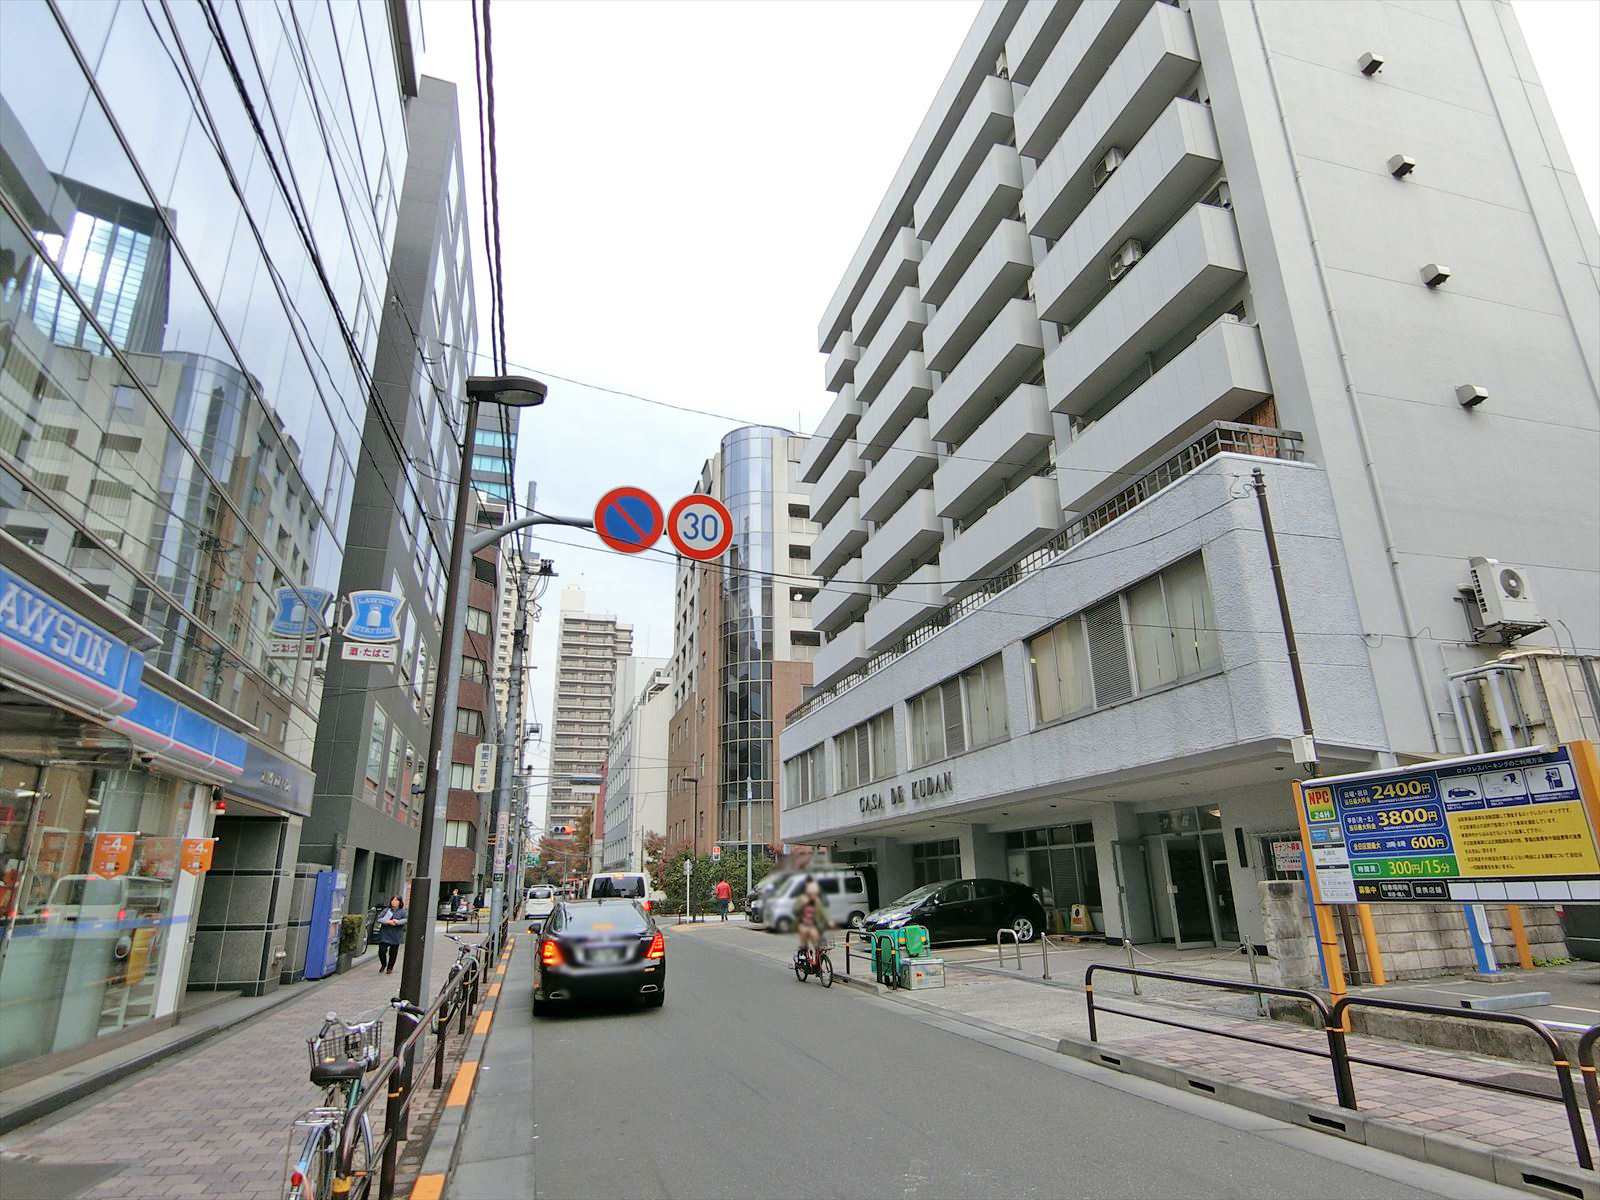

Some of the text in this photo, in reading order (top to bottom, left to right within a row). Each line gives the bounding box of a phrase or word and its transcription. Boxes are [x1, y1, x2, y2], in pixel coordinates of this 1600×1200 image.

[683, 512, 718, 542] 30
[358, 597, 395, 607] LAWSON
[353, 624, 393, 634] STATION
[349, 646, 390, 659] 酒・たばこ
[480, 745, 490, 784] 精密工学会
[859, 771, 953, 813] CASA DE KUDAN
[1371, 780, 1432, 800] 2400円
[1308, 790, 1330, 806] NPC
[1314, 811, 1331, 820] 24H
[1376, 808, 1438, 826] 3800円
[112, 837, 122, 851] 4
[196, 842, 205, 852] 4
[1274, 842, 1301, 853] テナント募集
[1410, 836, 1445, 849] 600円
[1357, 865, 1377, 873] 時間貸
[1388, 859, 1451, 875] 300円/15分
[1358, 885, 1377, 894] 募集中
